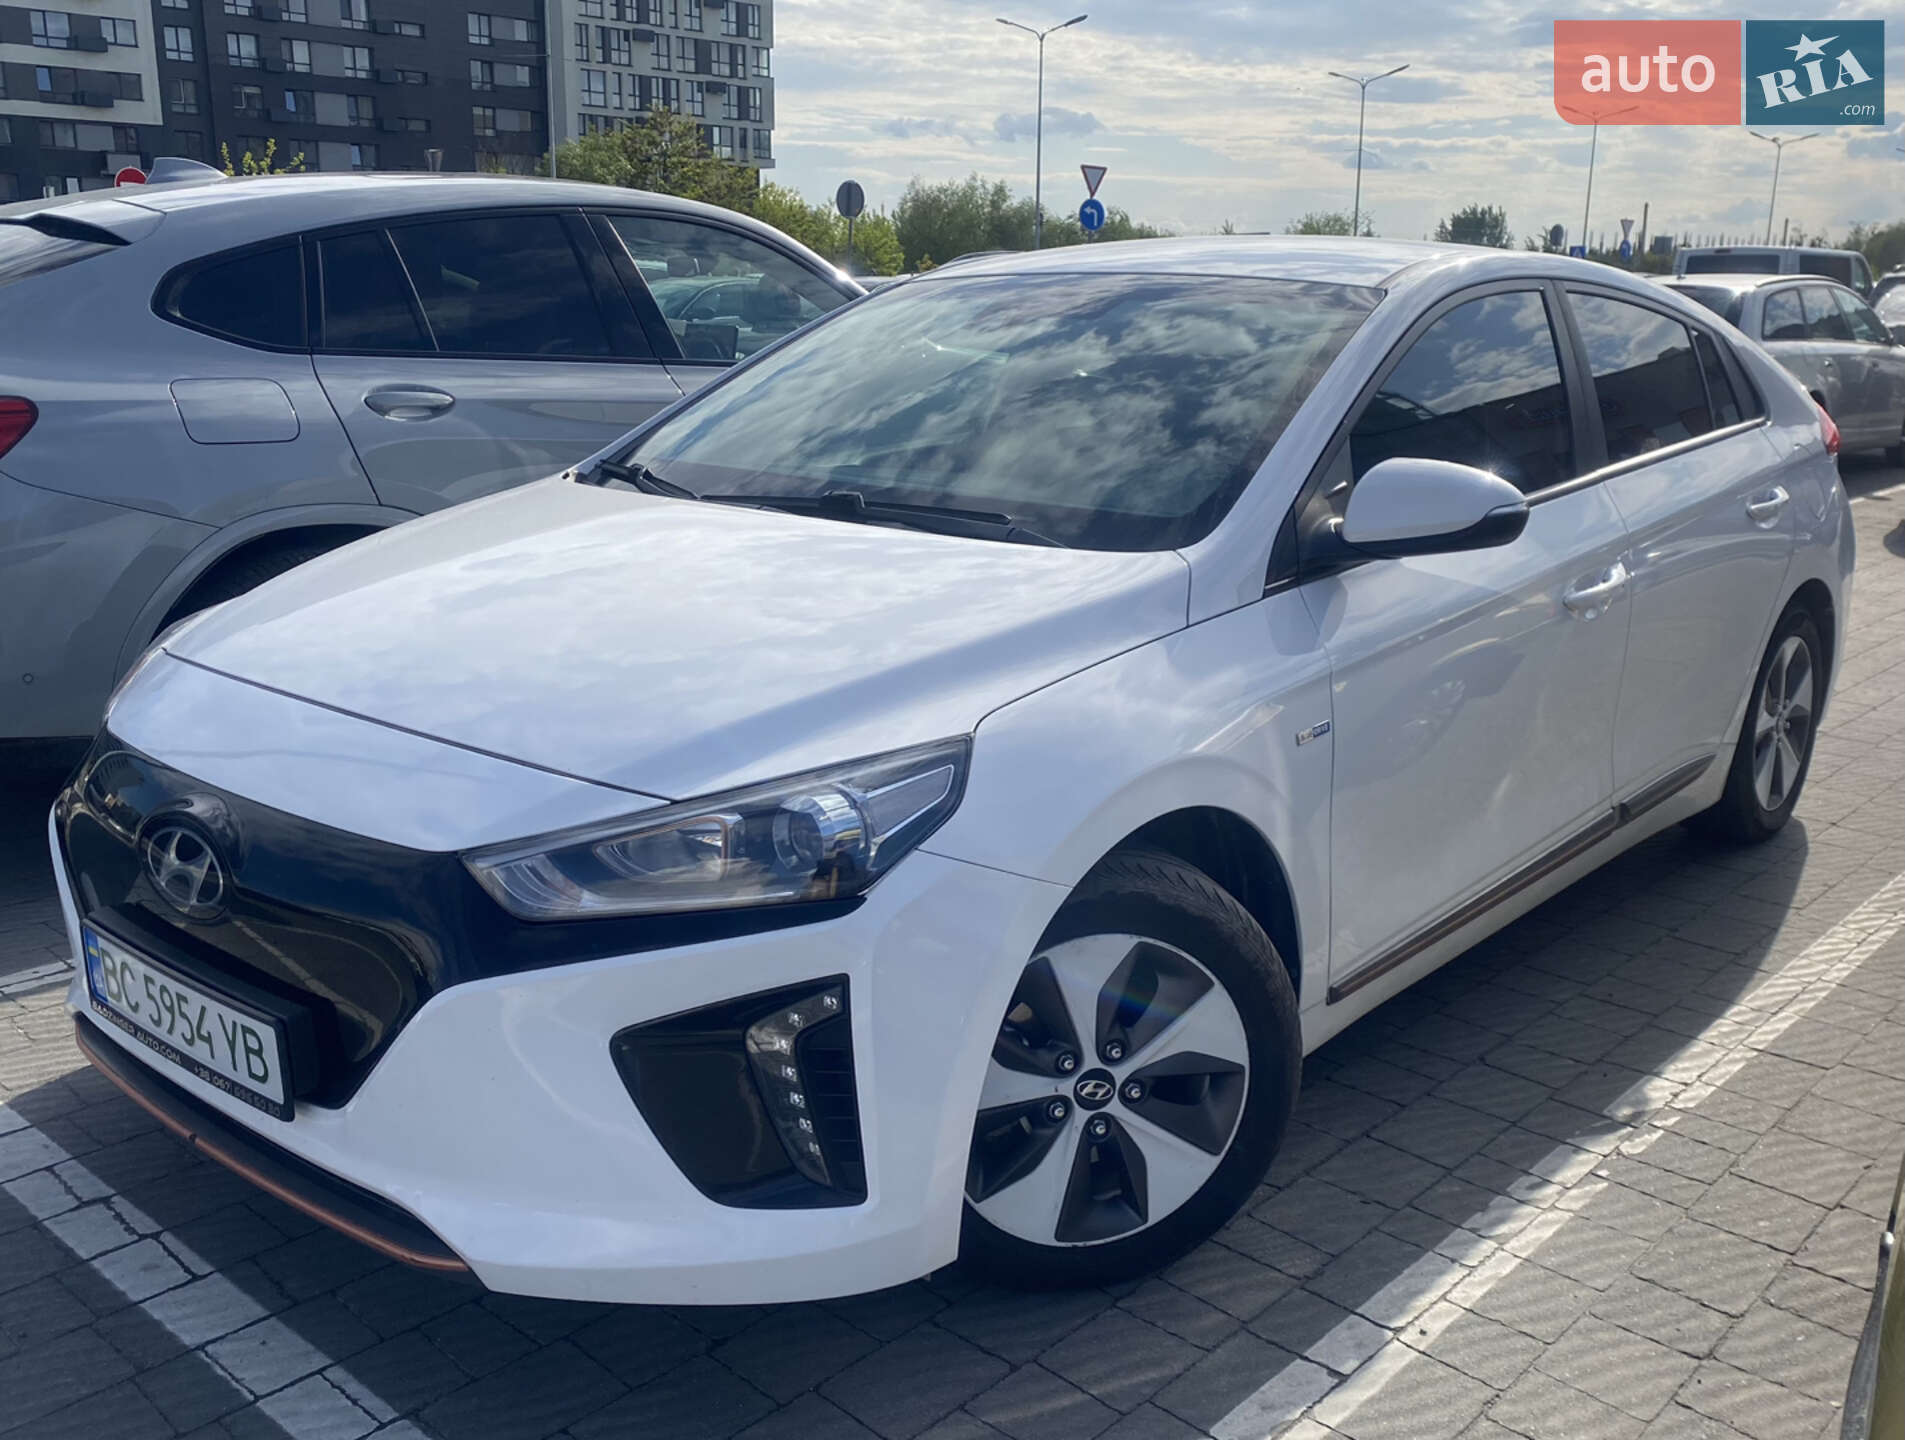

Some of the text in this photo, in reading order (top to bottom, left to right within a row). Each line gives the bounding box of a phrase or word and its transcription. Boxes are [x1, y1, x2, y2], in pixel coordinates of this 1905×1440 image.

[100, 946, 269, 1084] BC 5954 YB
